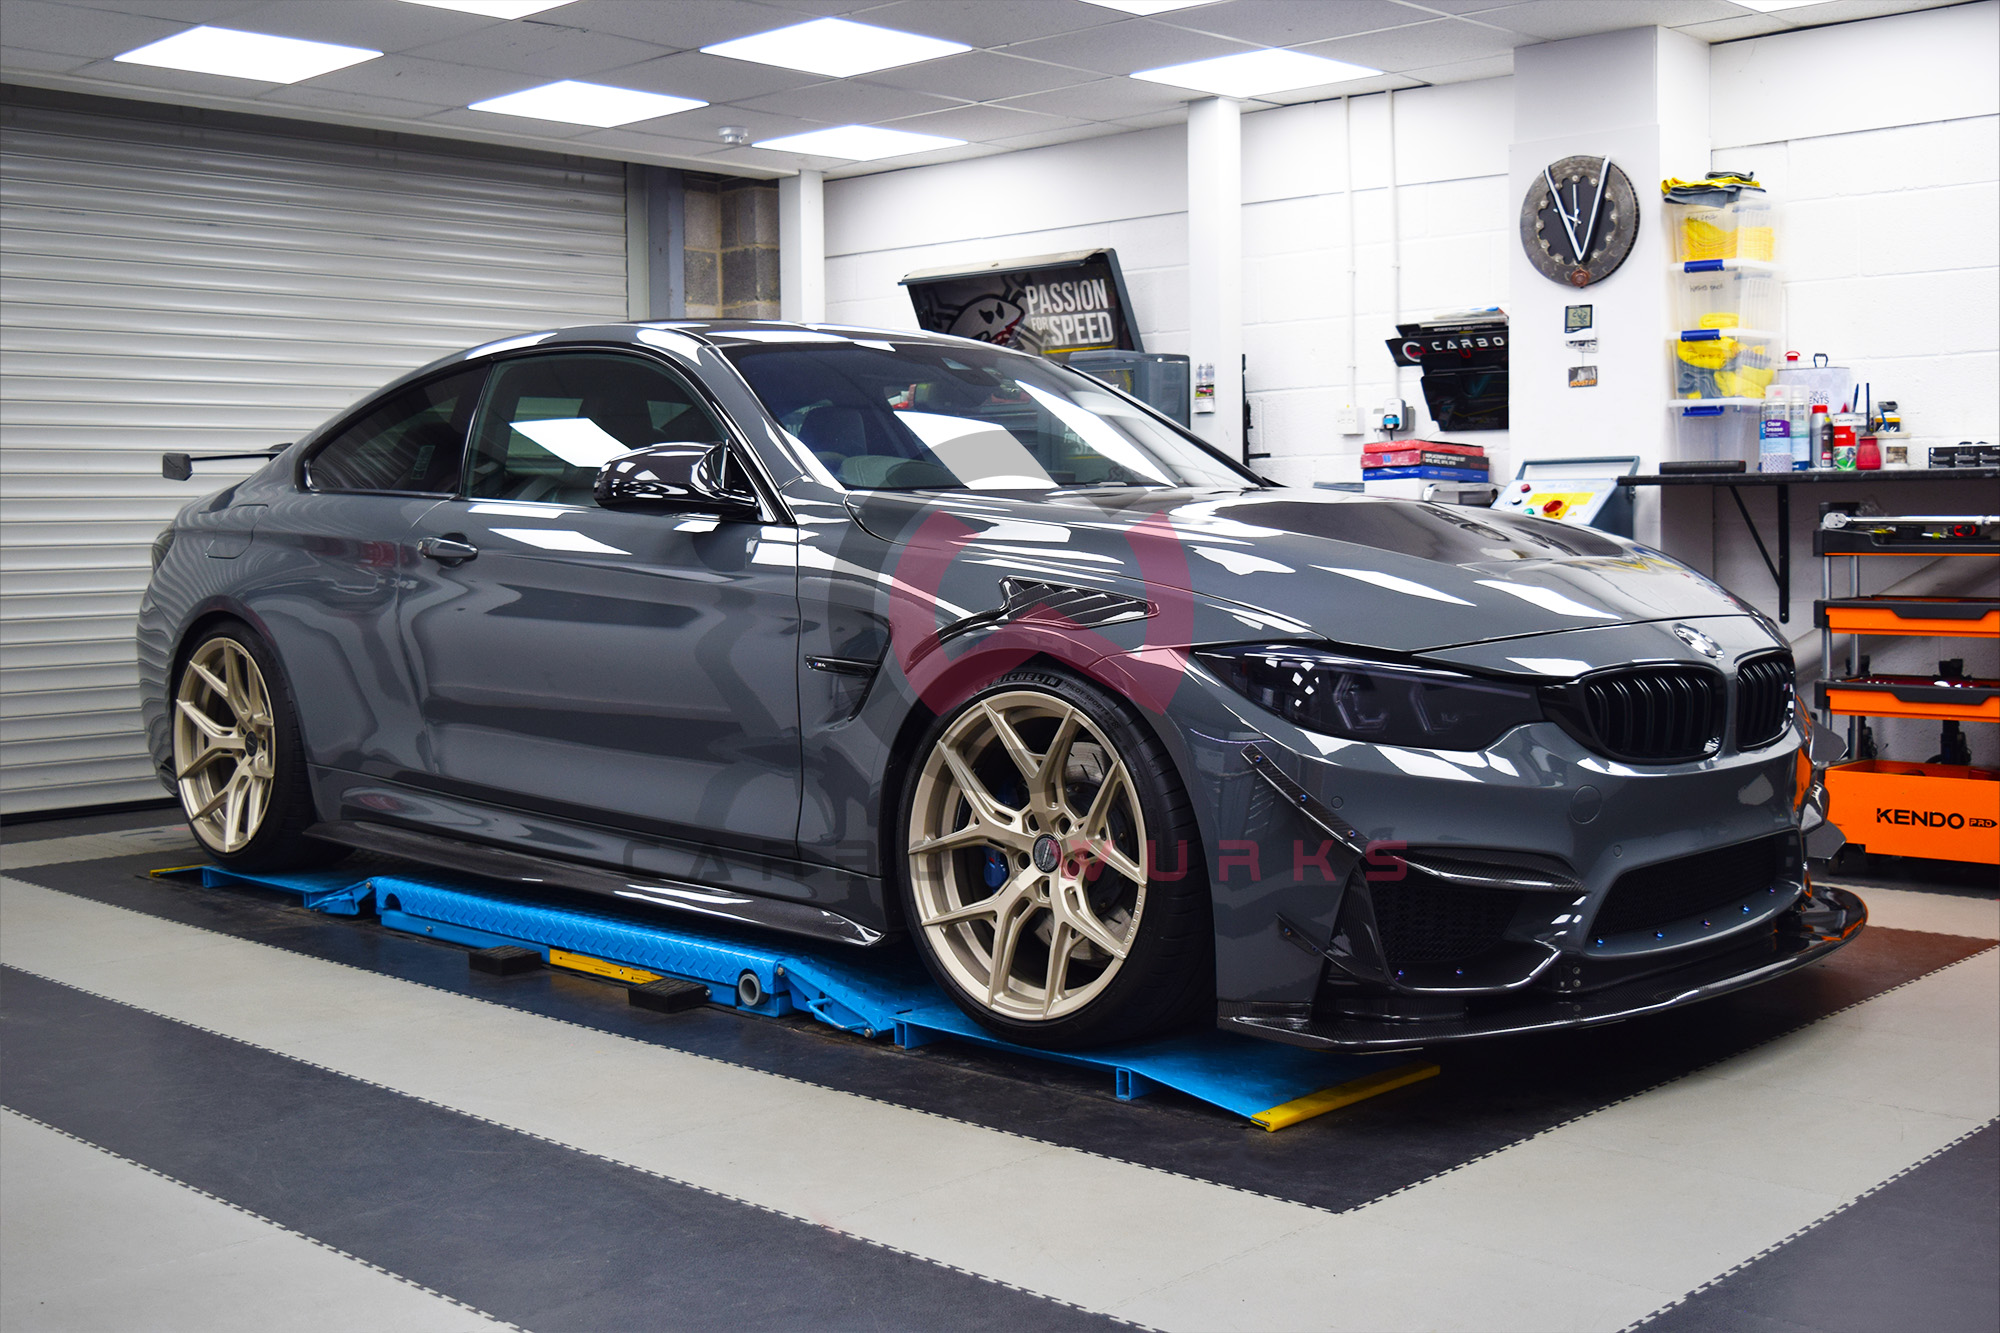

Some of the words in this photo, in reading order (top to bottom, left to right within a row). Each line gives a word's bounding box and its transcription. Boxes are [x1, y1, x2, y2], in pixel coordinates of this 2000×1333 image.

[1025, 279, 1109, 314] PASSION
[1032, 317, 1048, 332] FOR
[1049, 312, 1113, 345] SPEED
[992, 671, 1058, 686] MICHELIN
[1876, 807, 1965, 830] KENDO
[1969, 818, 1993, 828] PRO
